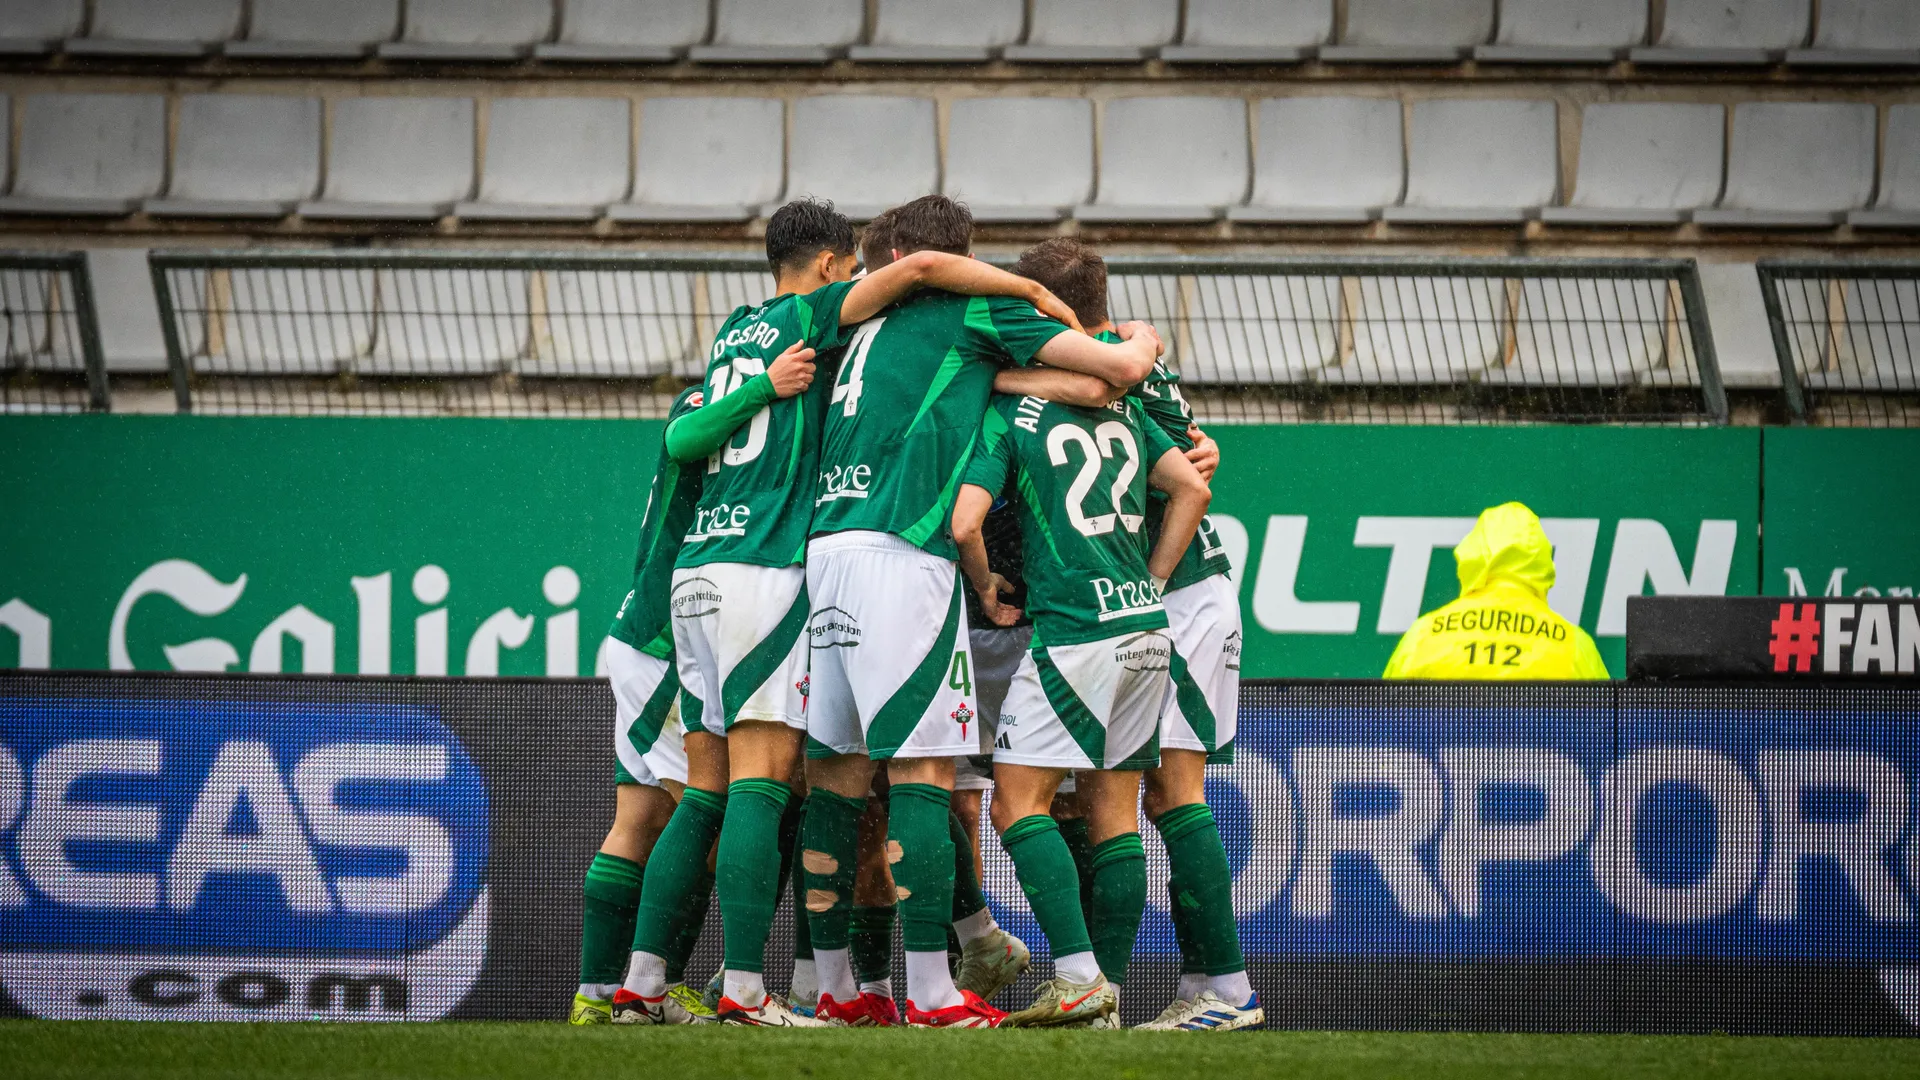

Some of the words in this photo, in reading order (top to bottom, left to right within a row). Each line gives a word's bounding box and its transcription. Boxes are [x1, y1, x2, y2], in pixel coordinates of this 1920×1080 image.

[830, 317, 887, 417] 4
[1046, 421, 1144, 537] 22
[109, 559, 612, 677] Galici
[1430, 608, 1567, 643] SEGURIDAD
[1462, 641, 1523, 667] 112
[948, 650, 971, 697] 4
[0, 738, 456, 915] EAS
